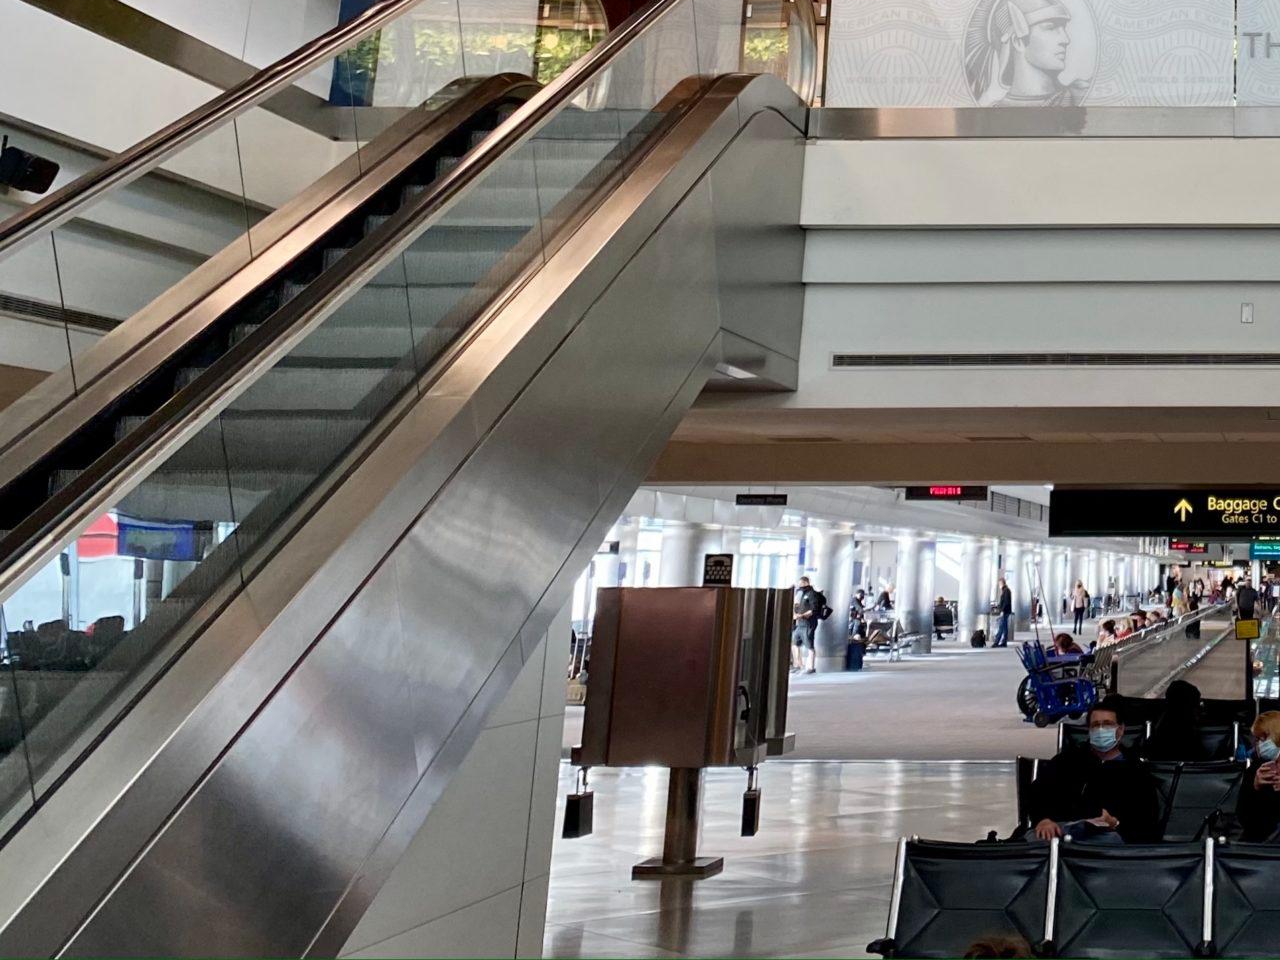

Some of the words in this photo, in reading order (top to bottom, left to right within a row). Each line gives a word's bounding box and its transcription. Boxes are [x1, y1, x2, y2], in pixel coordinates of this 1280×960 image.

[833, 9, 901, 31] MERICAN
[1207, 496, 1268, 514] Baggage
[1221, 513, 1249, 524] Gates
[1252, 513, 1263, 524] C1
[1266, 514, 1278, 524] to
